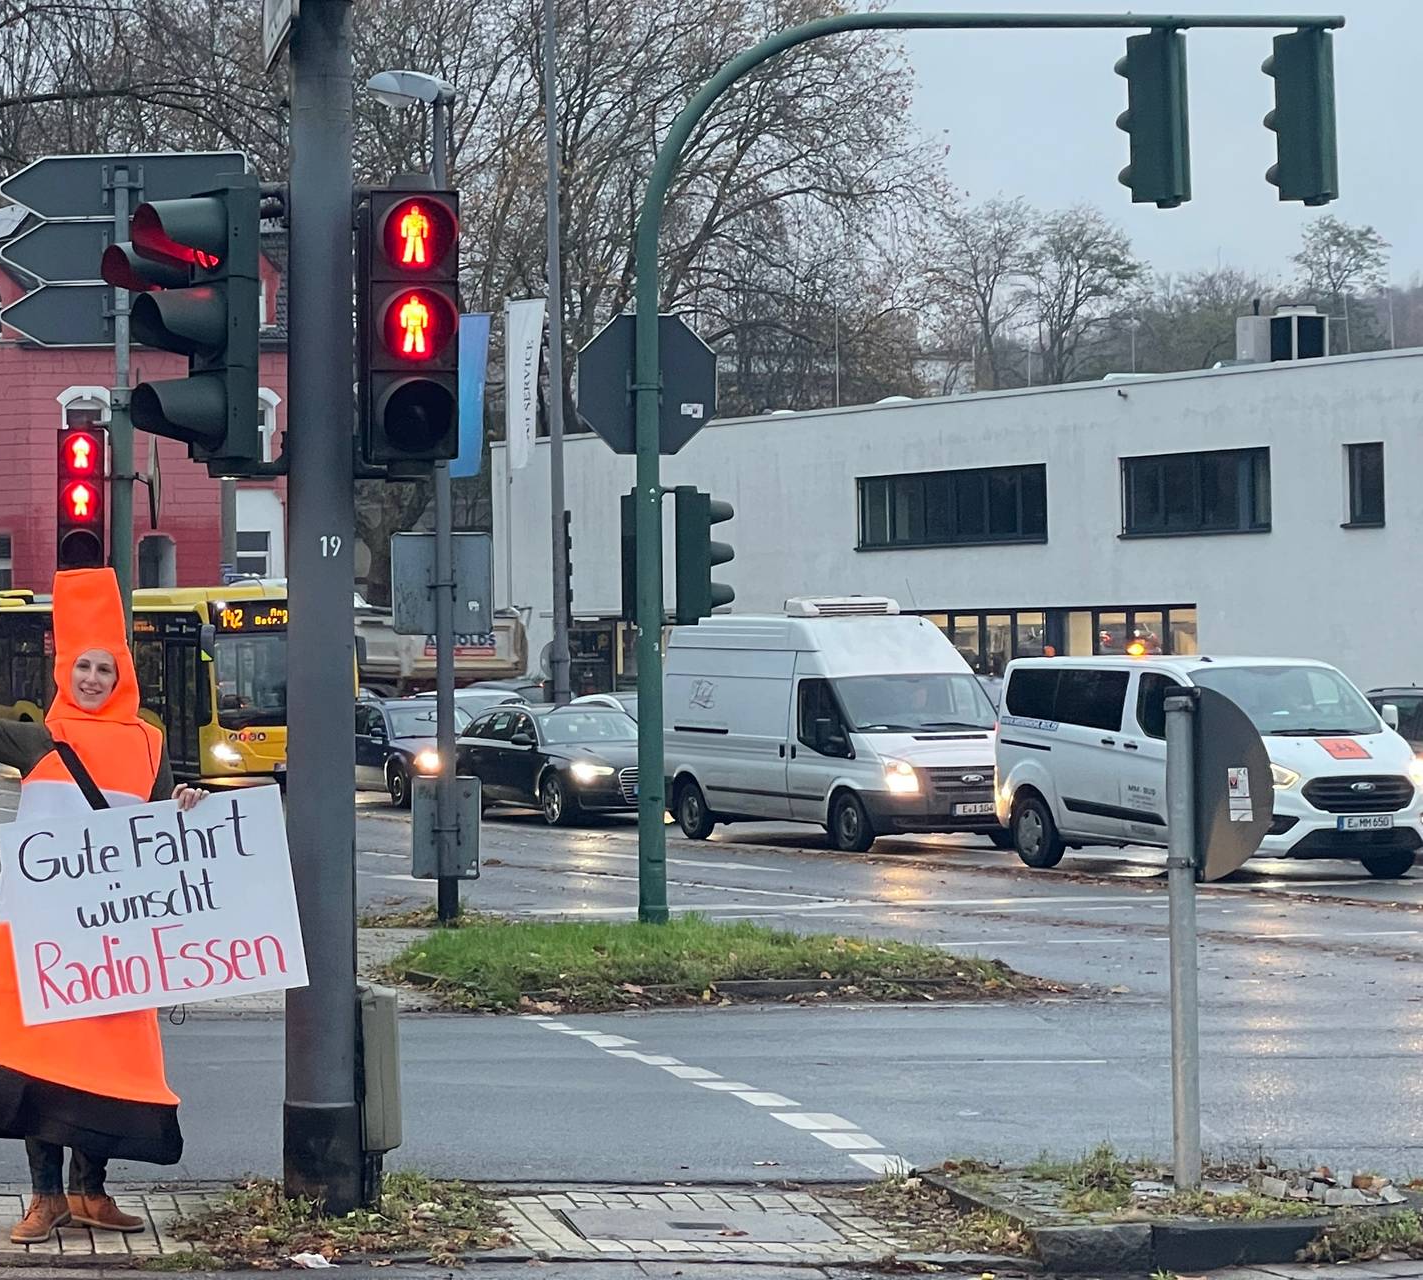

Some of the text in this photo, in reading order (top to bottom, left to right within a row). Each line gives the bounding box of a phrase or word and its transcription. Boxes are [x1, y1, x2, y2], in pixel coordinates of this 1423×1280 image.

[320, 535, 342, 557] 19
[220, 608, 243, 629] 142
[425, 632, 496, 646] AOLDS
[1347, 818, 1355, 828] E
[18, 799, 255, 883] Gute Fahrt
[77, 868, 222, 929] wünscht
[34, 924, 288, 1010] Radio Essen
